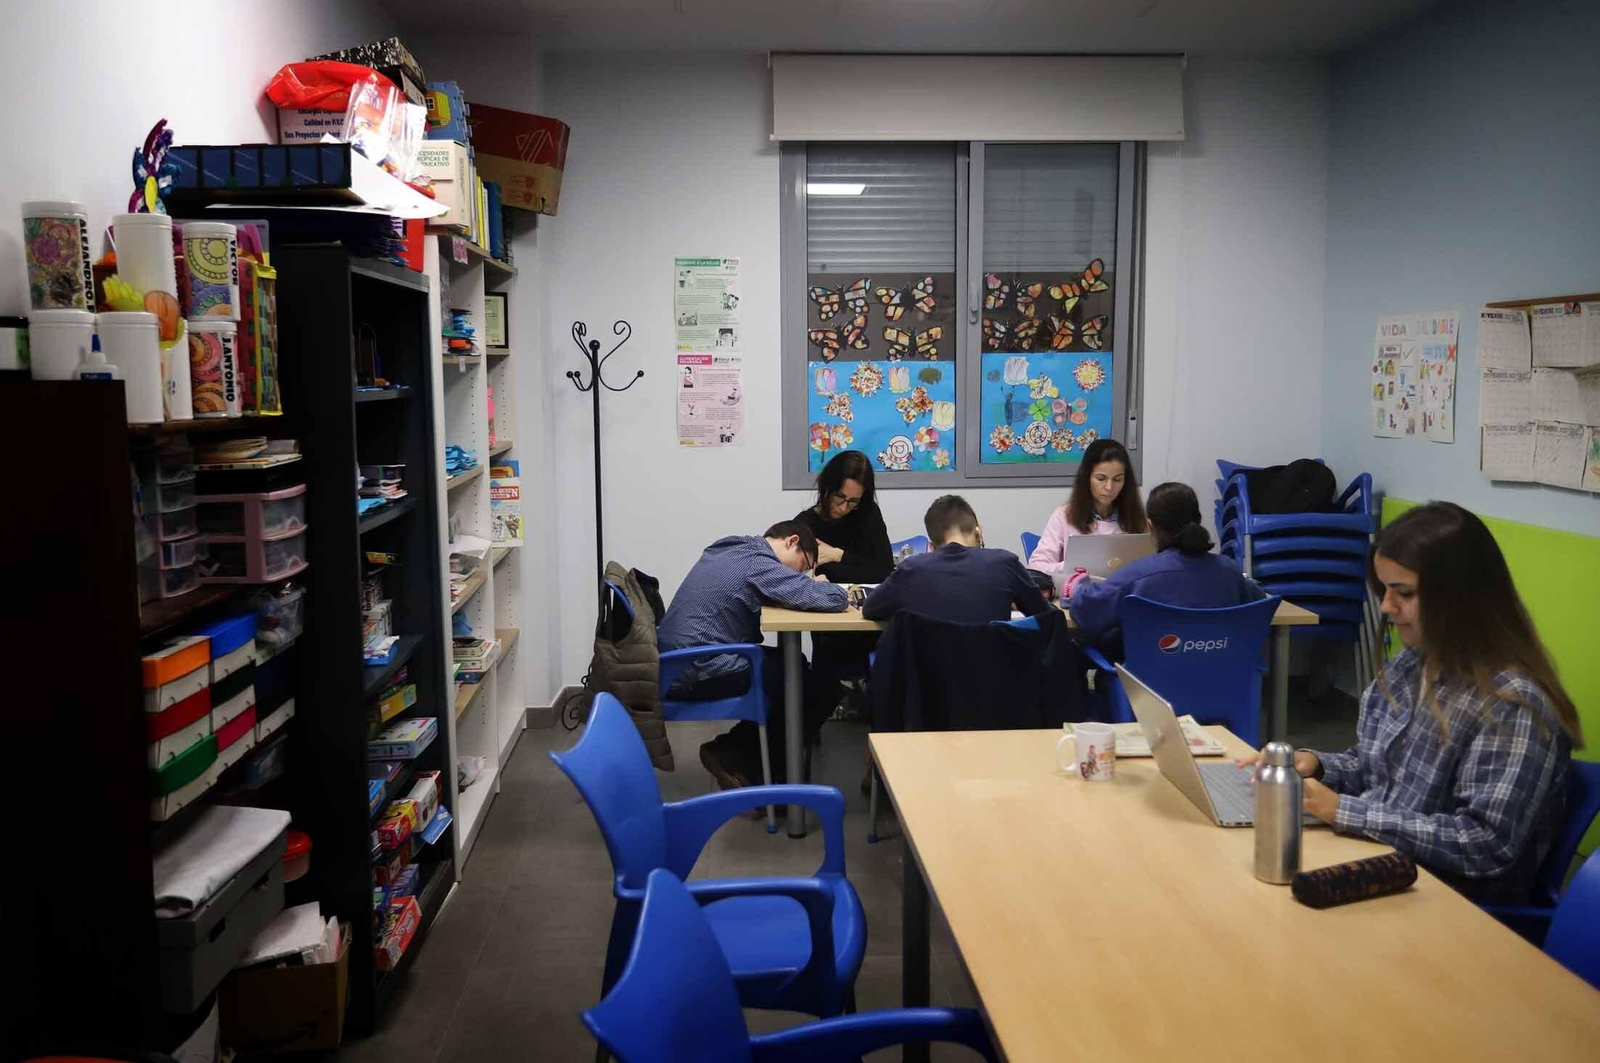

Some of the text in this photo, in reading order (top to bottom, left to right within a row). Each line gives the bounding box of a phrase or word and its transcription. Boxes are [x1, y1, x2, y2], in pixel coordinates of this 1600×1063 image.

[1381, 324, 1406, 336] VIDA
[222, 337, 235, 402] J.ANTONIO
[1183, 636, 1228, 653] pepsi
